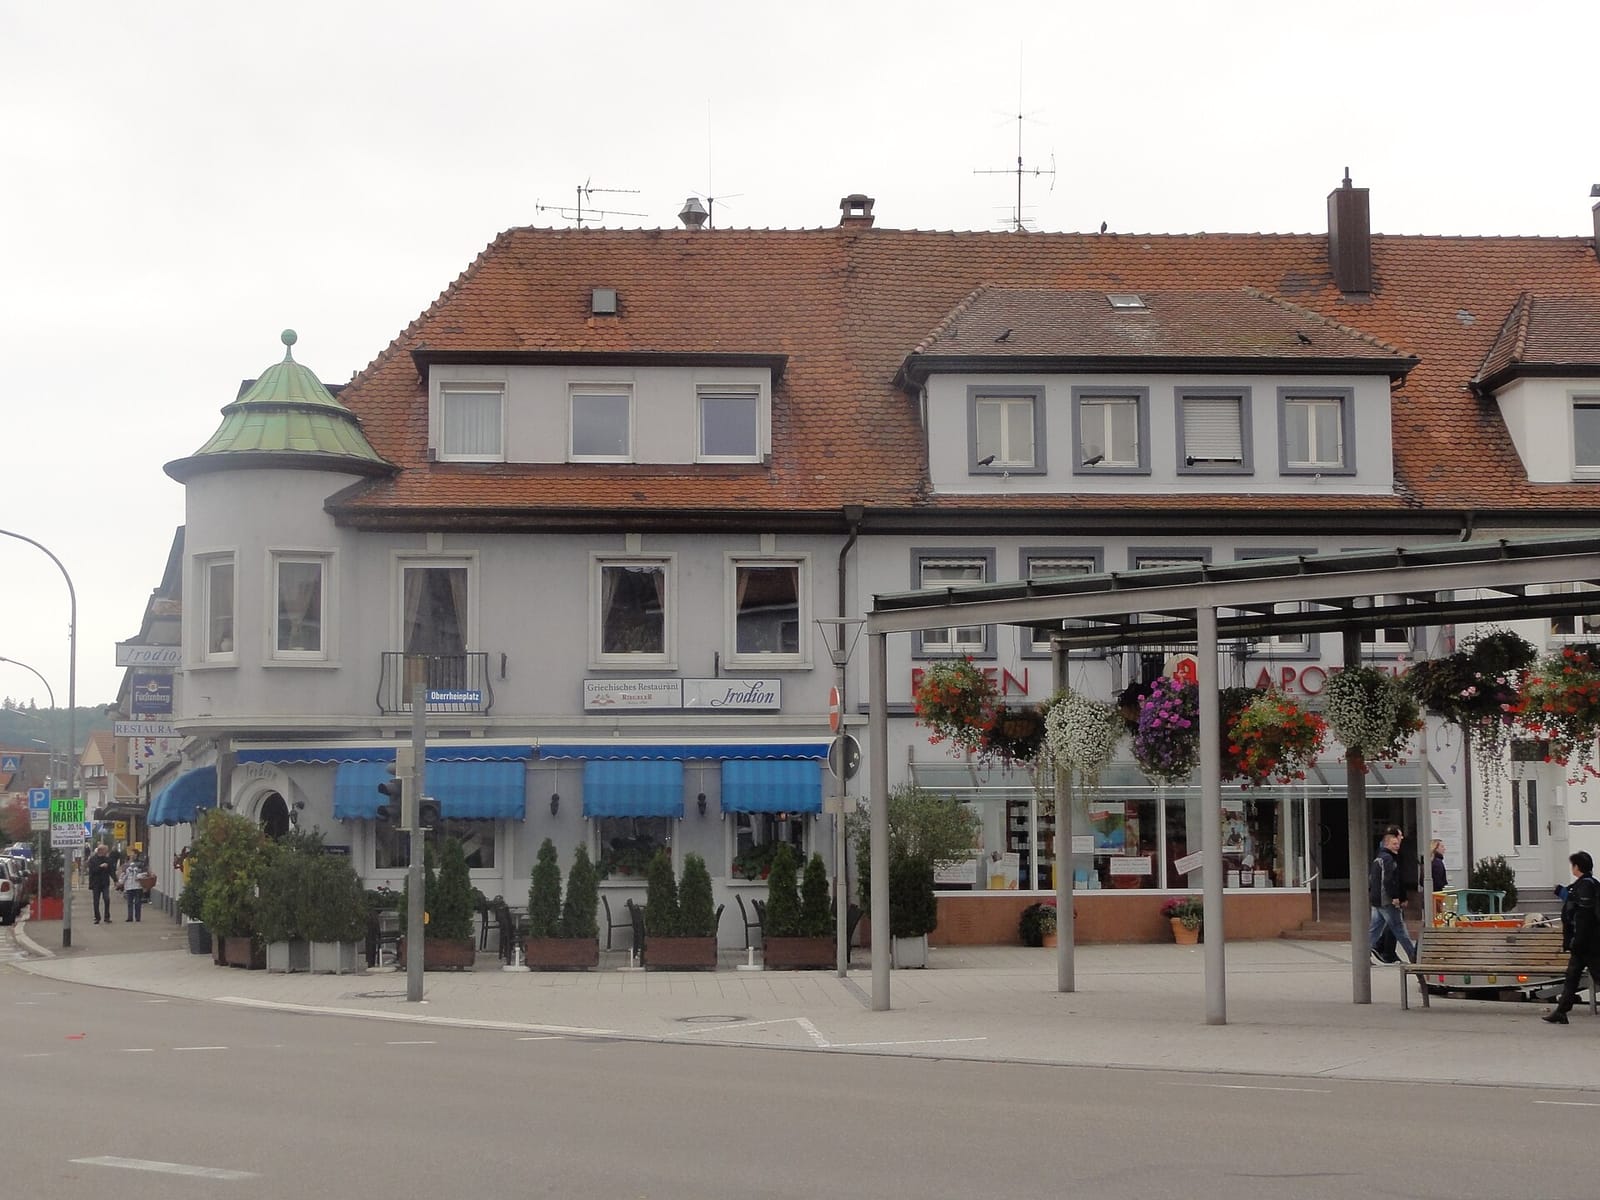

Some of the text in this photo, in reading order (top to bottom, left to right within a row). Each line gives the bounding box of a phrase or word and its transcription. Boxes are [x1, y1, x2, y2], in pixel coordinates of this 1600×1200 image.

[587, 682, 678, 692] Griechisches Restaurant
[431, 691, 479, 702] Oberrheinplatz
[33, 791, 46, 808] P
[1580, 791, 1588, 804] 3
[52, 811, 83, 823] MARKT
